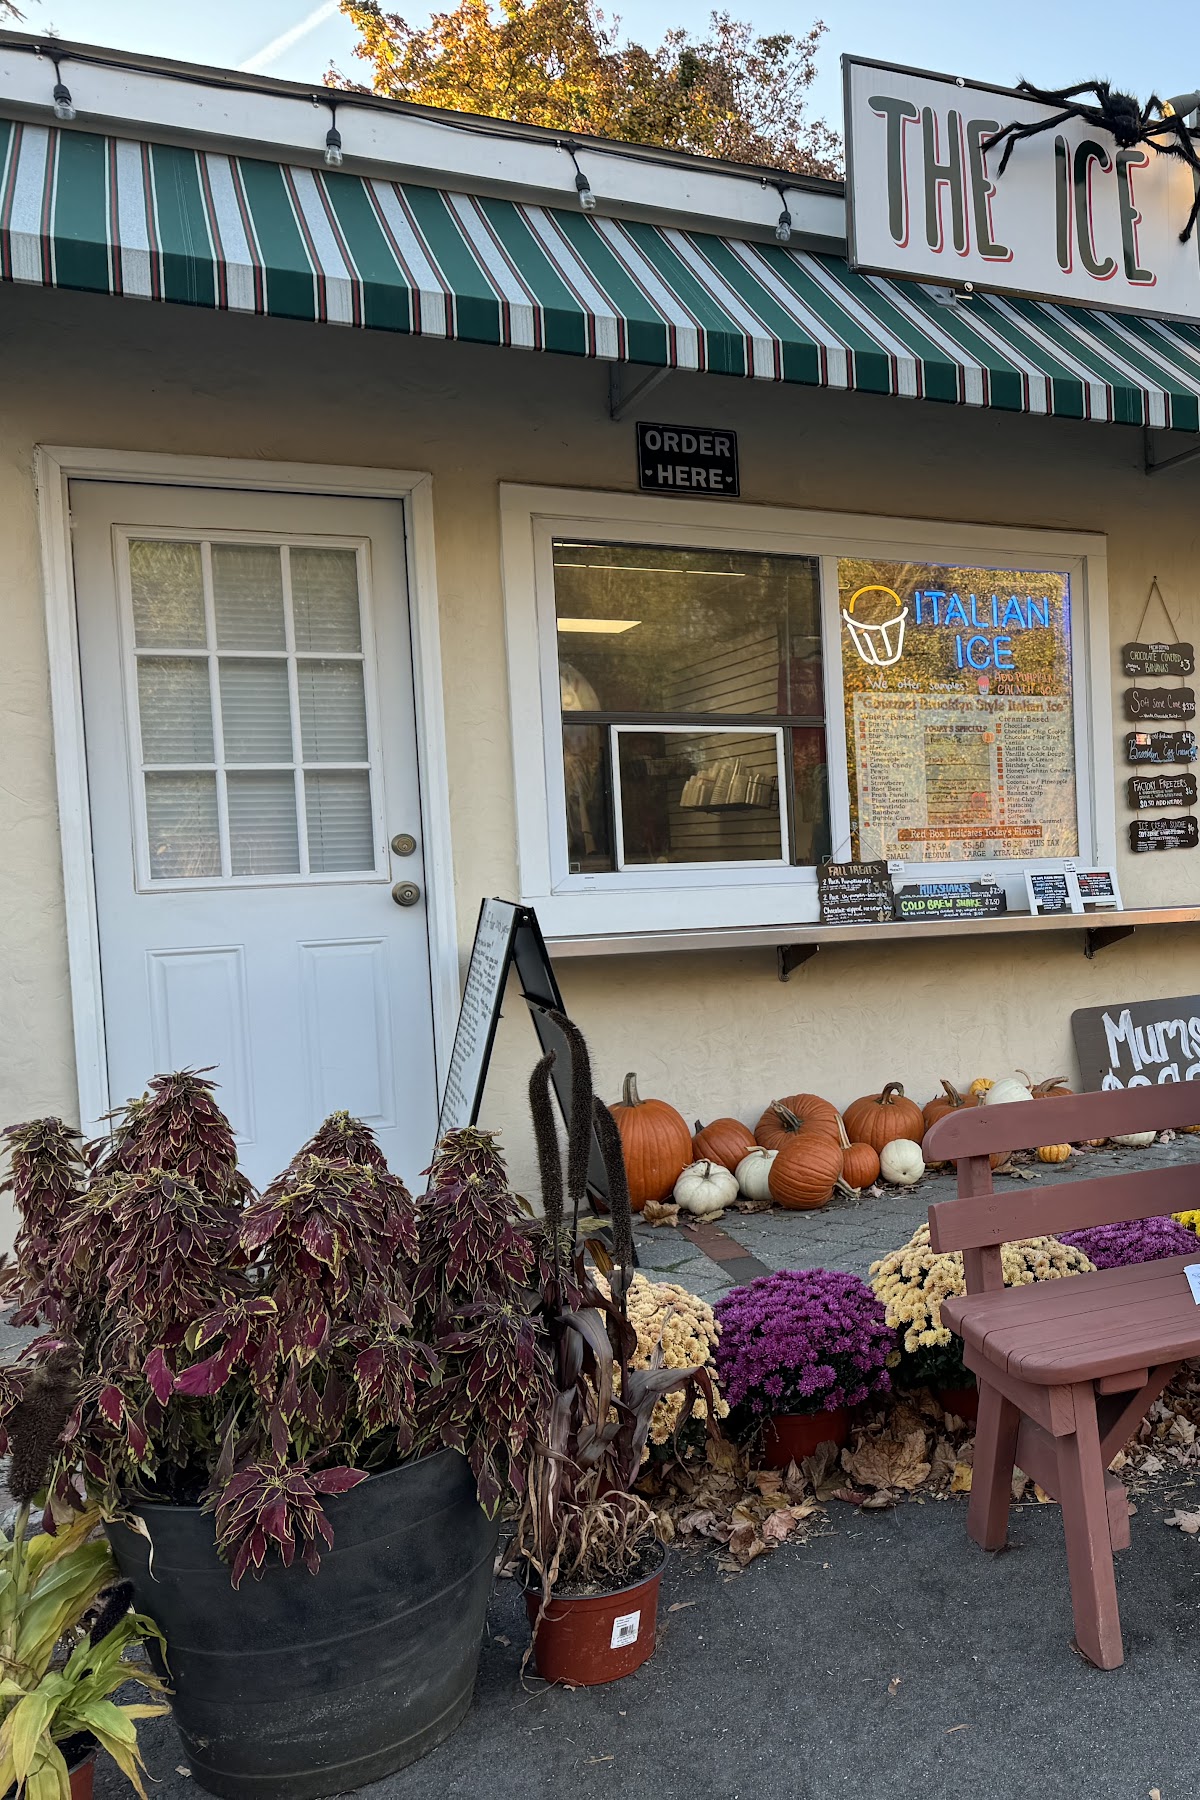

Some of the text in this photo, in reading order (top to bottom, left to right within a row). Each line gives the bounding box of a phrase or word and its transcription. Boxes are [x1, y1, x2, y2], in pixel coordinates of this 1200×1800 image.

[867, 95, 1014, 263] THE
[1054, 135, 1157, 287] ICE
[645, 430, 730, 457] ORDER
[657, 464, 724, 489] HERE
[914, 590, 1050, 629] ITALIAN
[955, 634, 1016, 670] ICE
[1180, 659, 1190, 671] $3
[866, 673, 969, 691] We offer samples!
[976, 698, 1004, 714] Style
[1007, 699, 1044, 712] Italian
[1133, 780, 1156, 792] FACTORY
[911, 827, 1041, 838] Red Box Indicates Today's Flavors
[1137, 822, 1148, 830] ICE
[828, 865, 881, 876] FALL TREATS:
[920, 884, 971, 894] MILKSHAKES
[901, 900, 925, 911] COLD
[927, 899, 953, 910] BREW
[956, 898, 982, 907] SHAKE
[877, 910, 892, 922] $2
